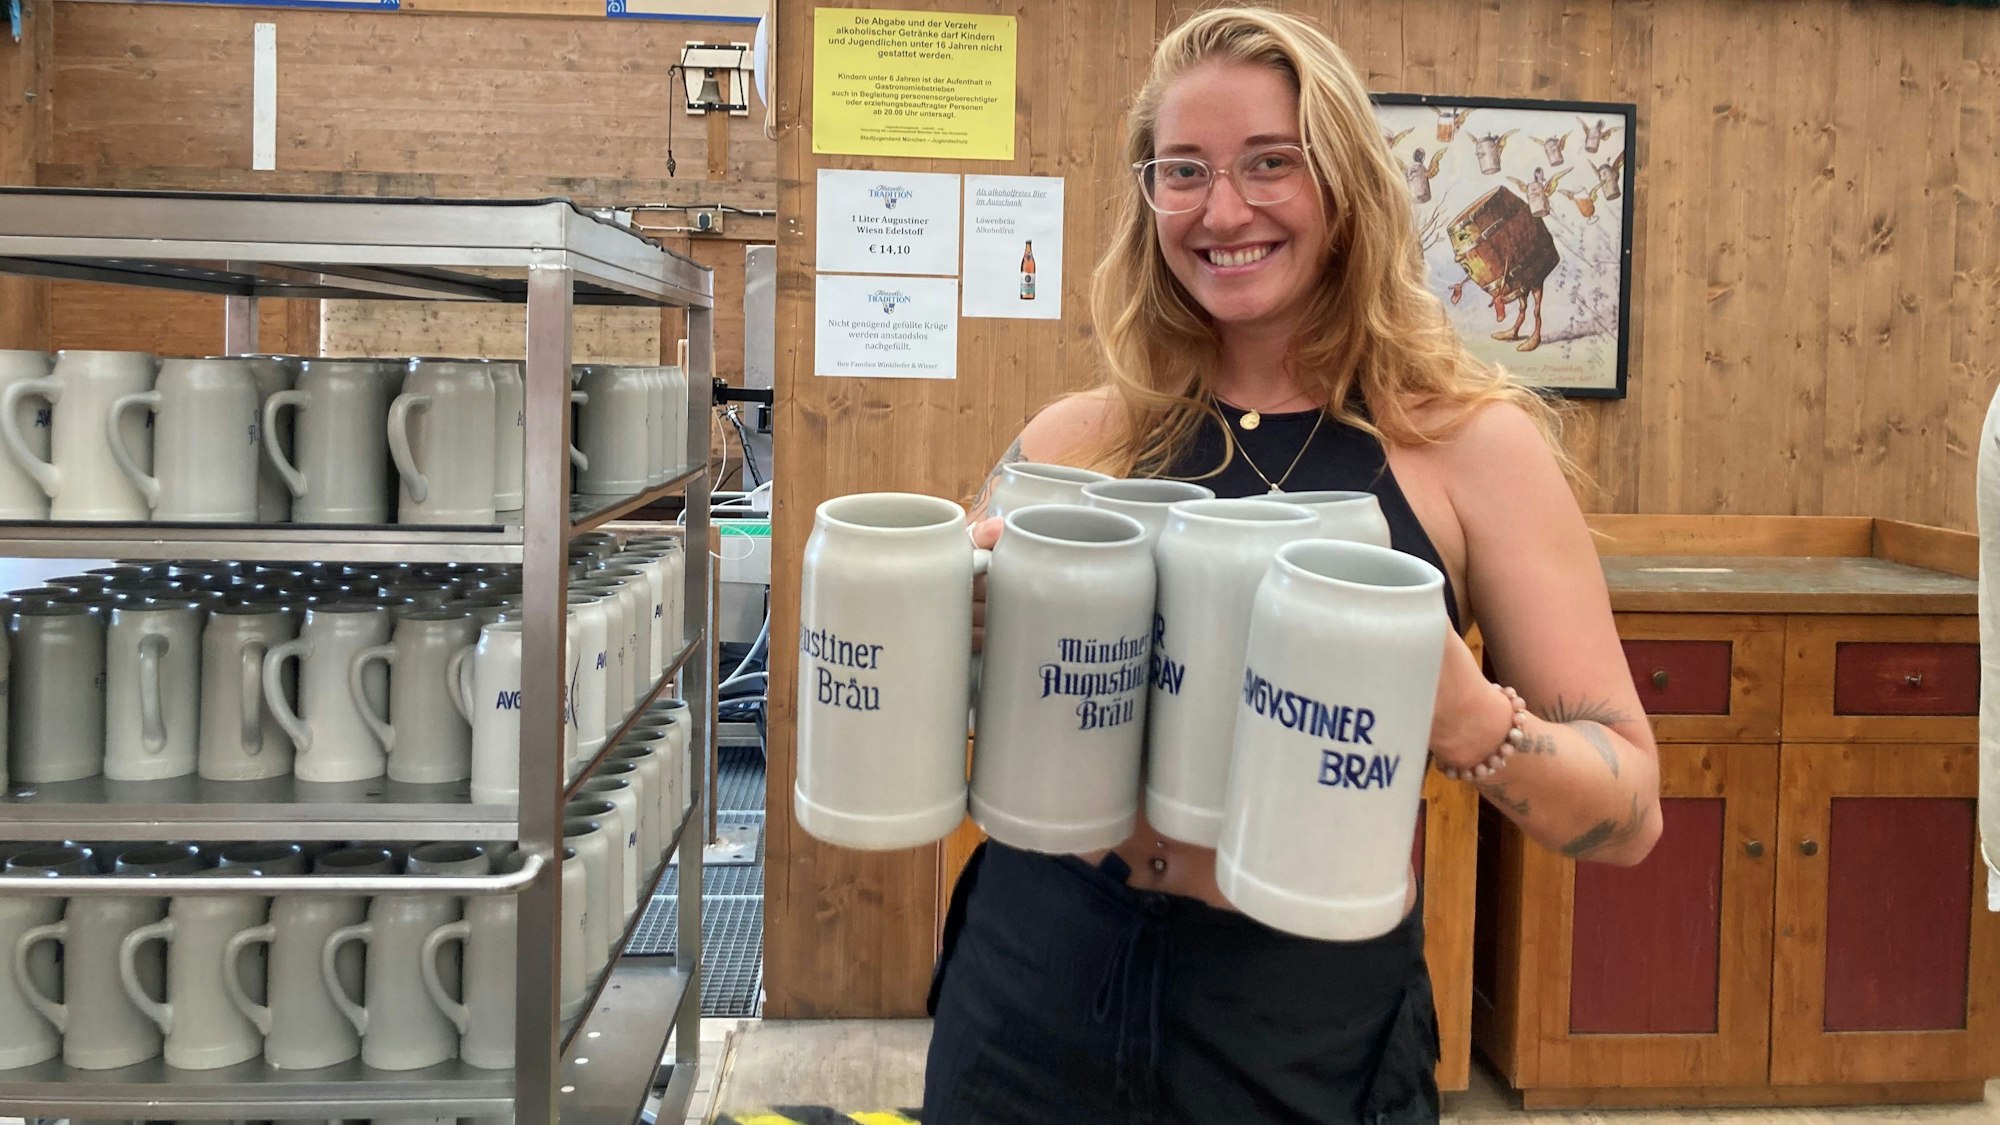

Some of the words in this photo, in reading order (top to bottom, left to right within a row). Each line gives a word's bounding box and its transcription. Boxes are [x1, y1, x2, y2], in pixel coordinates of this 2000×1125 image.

[855, 17, 870, 25] Die
[871, 17, 906, 27] Abgabe
[908, 19, 925, 27] und
[927, 20, 942, 28] der
[944, 20, 978, 29] Verzehr
[836, 27, 896, 36] alkoholischer
[898, 29, 939, 38] Getränke
[941, 31, 959, 39] darf
[960, 32, 995, 41] Kindern
[828, 37, 845, 45] und
[848, 38, 907, 47] Jugendlichen
[936, 41, 946, 49] 16
[948, 42, 978, 51] Jahren
[980, 44, 1003, 52] nicht
[877, 50, 916, 59] gestattet
[919, 51, 954, 60] werden.
[838, 73, 867, 81] Kindern
[946, 78, 983, 86] Aufenthalt
[875, 83, 955, 93] Gastronomiebetrieben
[860, 91, 899, 100] Begleitung
[900, 93, 998, 104] personensorgeberechtigter
[864, 101, 948, 110] erziehungsbeauftragter
[949, 103, 984, 111] Personen
[920, 111, 956, 119] untersagt.
[869, 189, 913, 198] TRADITION
[976, 188, 987, 197] Als
[986, 199, 1022, 207] Ausschank
[852, 214, 856, 222] 1
[859, 214, 879, 223] Liter
[881, 216, 929, 225] Augustiner
[976, 217, 1015, 225] Löwenbräu
[857, 226, 883, 234] Wiesn
[885, 227, 924, 235] Edelstoff
[976, 226, 1014, 234] Alkoholfrei
[869, 244, 877, 254] €
[880, 244, 911, 255] 14,10
[867, 294, 911, 303] TRADITION
[828, 319, 849, 327] Nicht
[851, 320, 891, 331] genügend
[924, 321, 948, 331] Krüge
[848, 331, 879, 339] werden
[880, 332, 928, 340] anstandslos
[801, 625, 884, 670] ustiner
[1151, 653, 1186, 696] RAV
[817, 666, 881, 711] Bräu
[1243, 666, 1376, 745] AVGVSTINER
[1076, 697, 1134, 730] Bräu
[1318, 748, 1402, 790] BRAV
